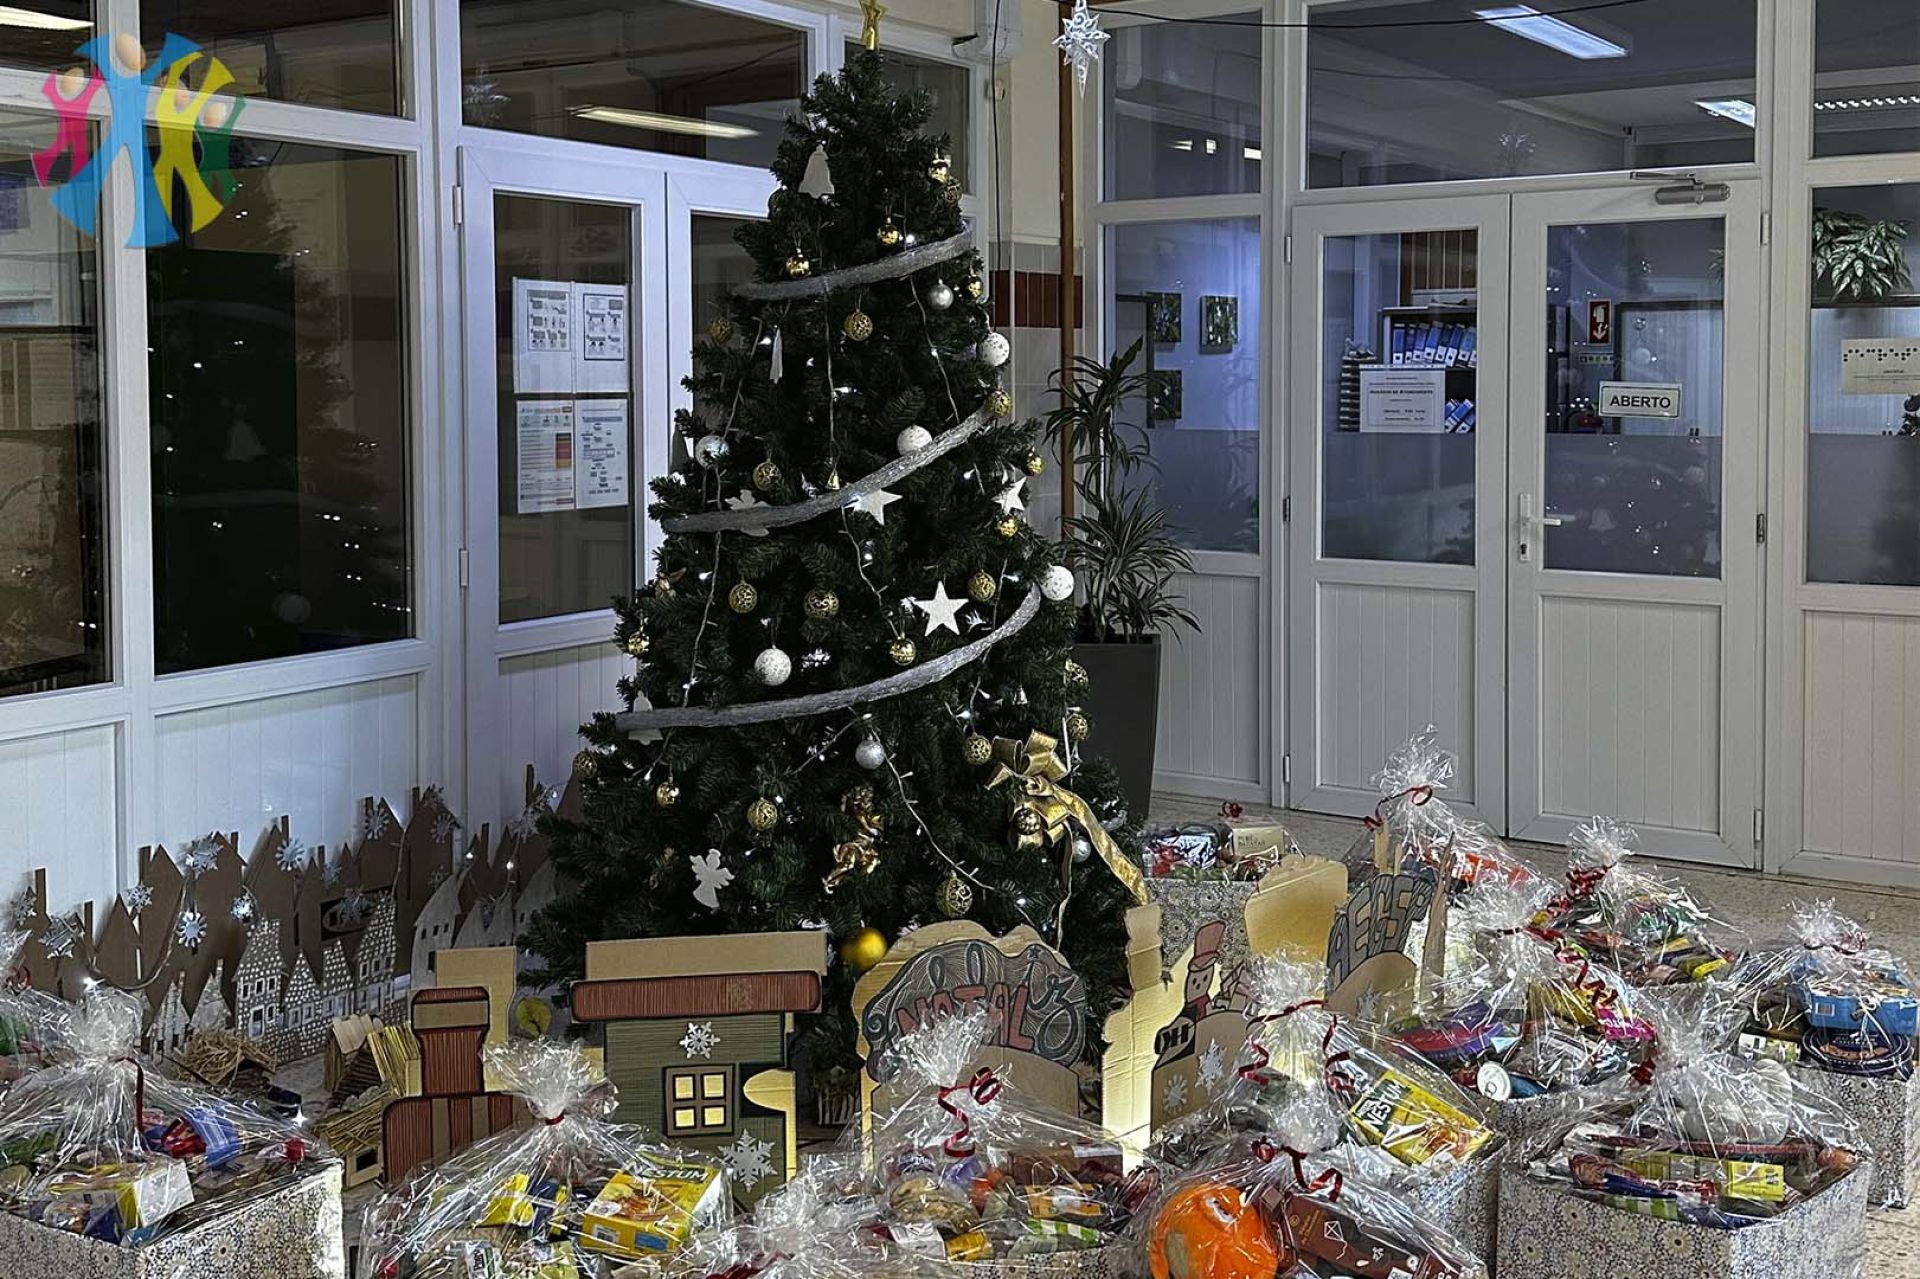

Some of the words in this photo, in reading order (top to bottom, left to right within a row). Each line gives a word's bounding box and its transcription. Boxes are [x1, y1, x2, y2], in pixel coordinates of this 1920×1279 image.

[1609, 395, 1671, 409] ABERTO
[1362, 1079, 1406, 1126] NESTUM
[624, 1160, 708, 1181] NESTUM
